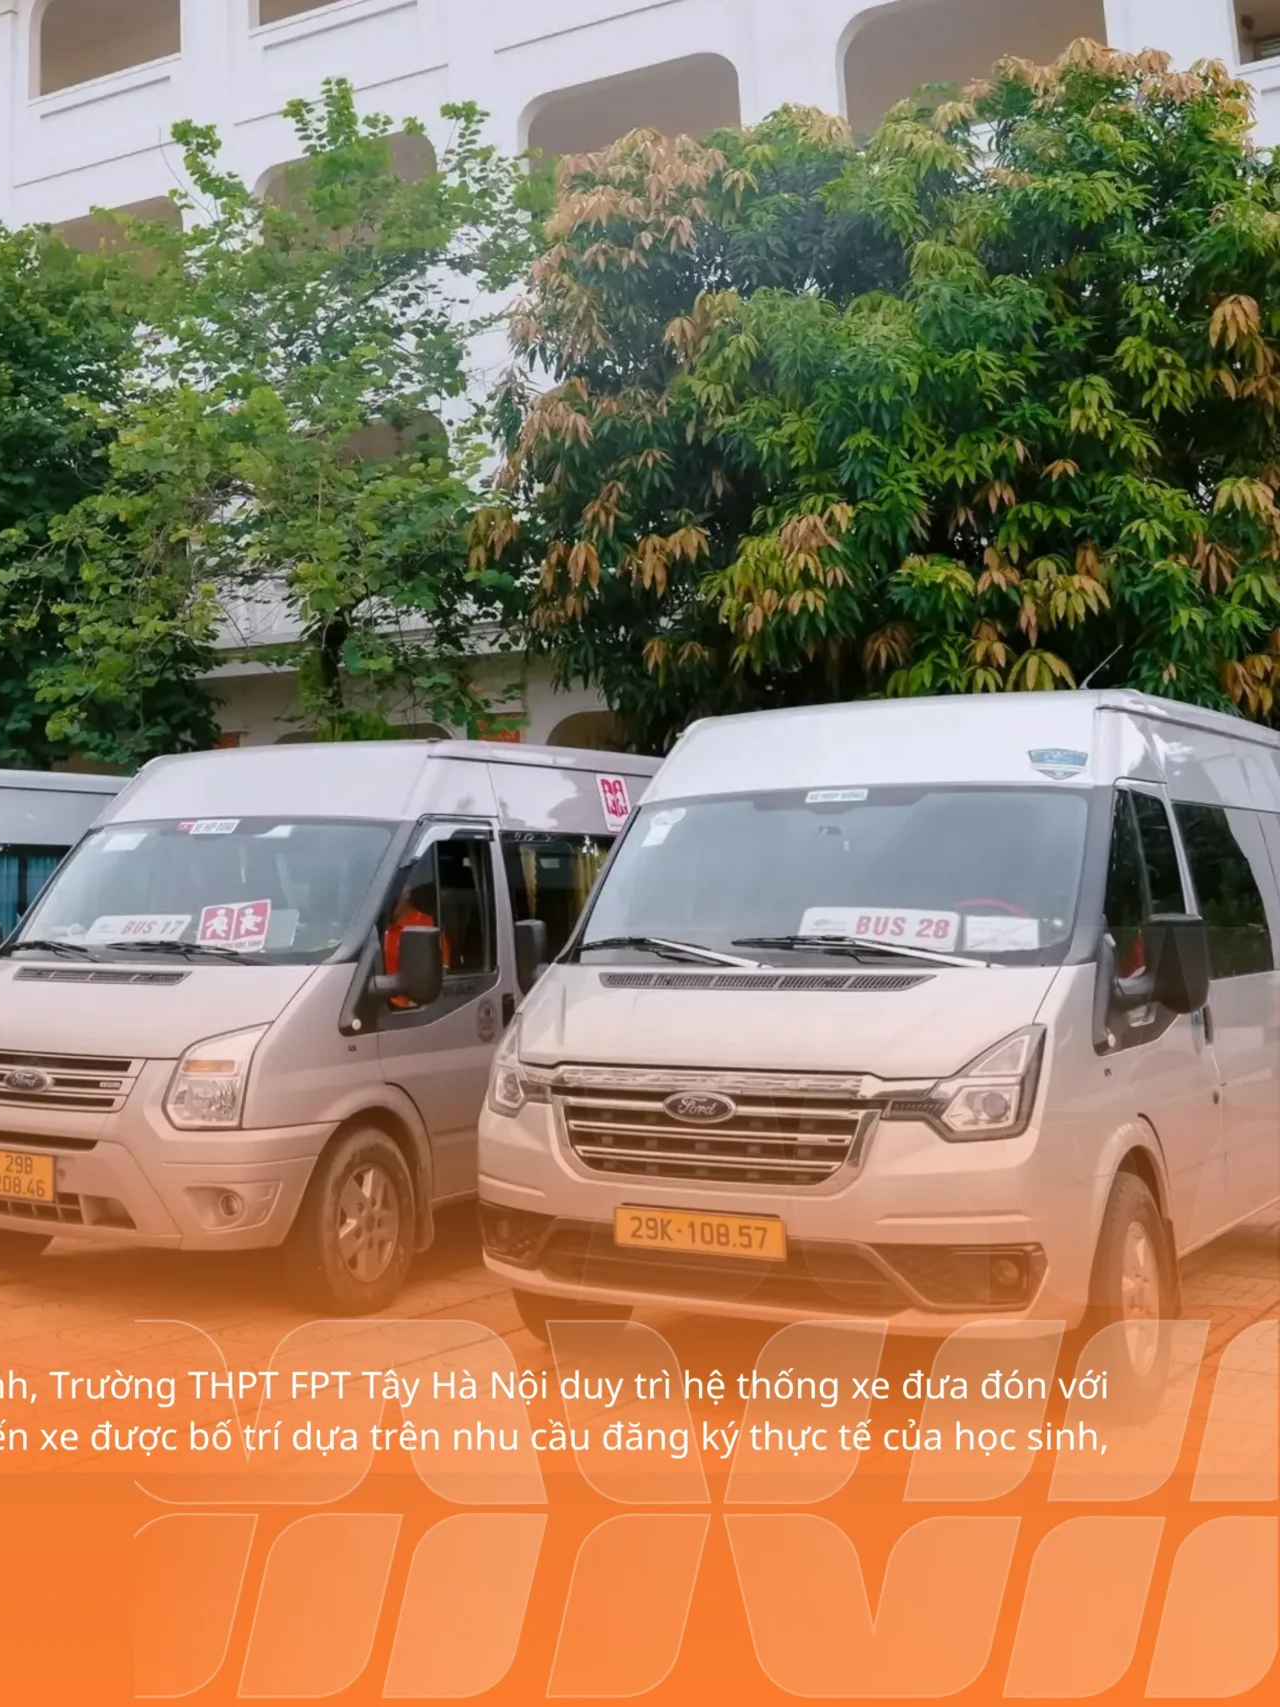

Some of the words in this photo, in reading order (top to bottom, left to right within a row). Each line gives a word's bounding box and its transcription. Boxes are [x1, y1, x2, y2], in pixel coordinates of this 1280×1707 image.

[121, 920, 157, 934] BUS
[160, 920, 185, 934] 17
[855, 915, 907, 936] BUS
[915, 918, 950, 939] 28
[11, 1071, 38, 1088] Ford
[677, 1096, 717, 1116] Ford
[4, 1154, 33, 1175] 29B
